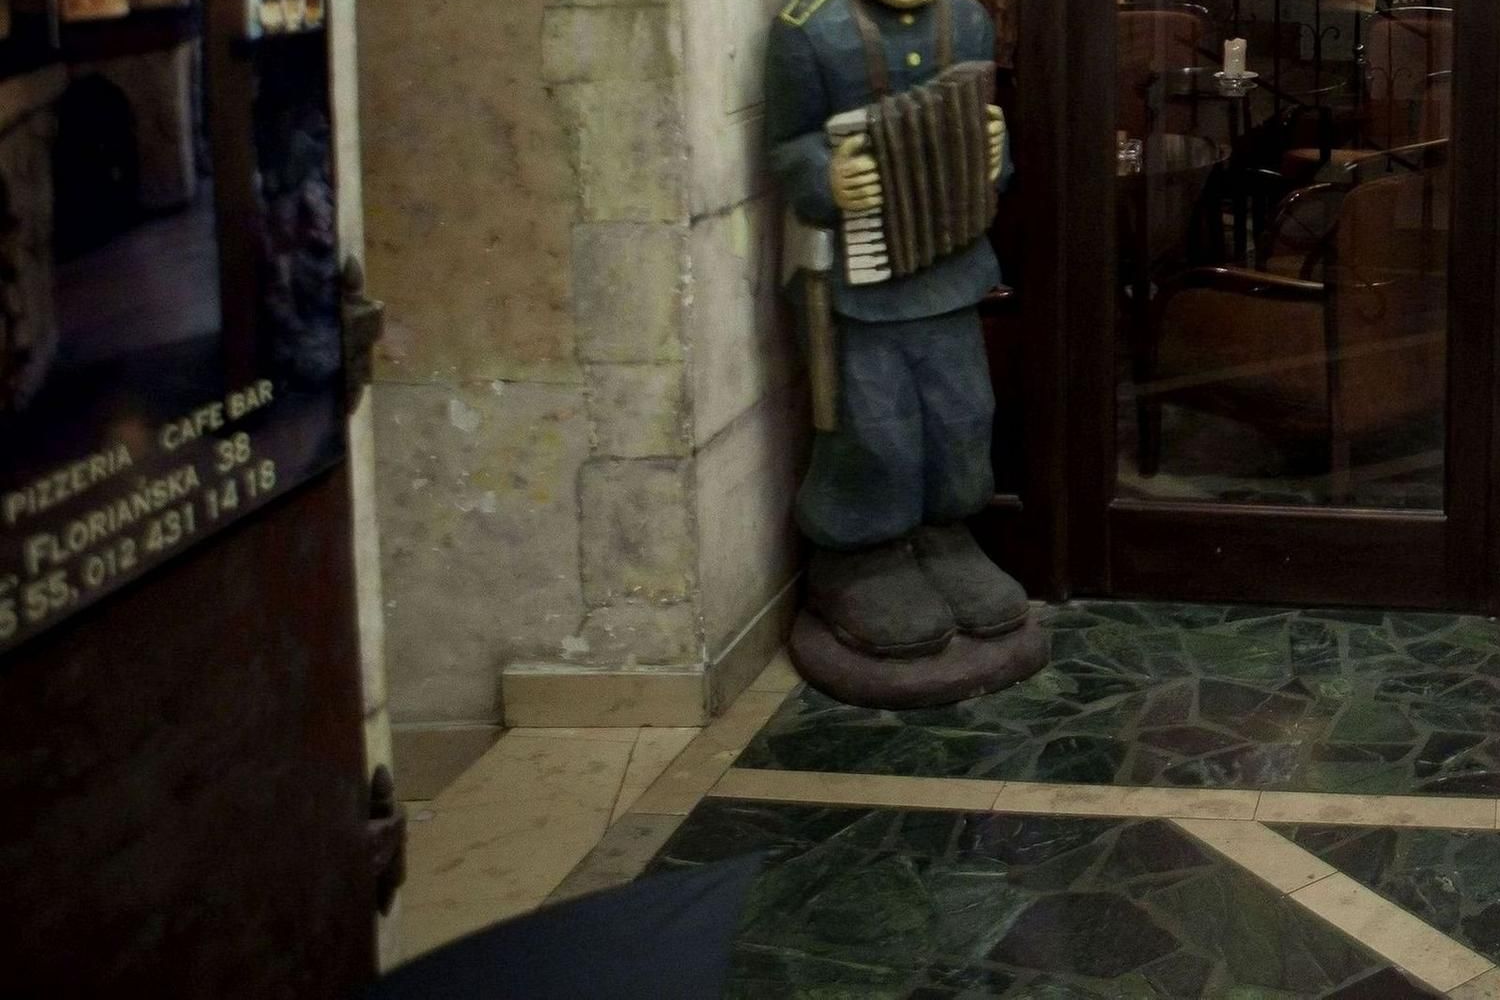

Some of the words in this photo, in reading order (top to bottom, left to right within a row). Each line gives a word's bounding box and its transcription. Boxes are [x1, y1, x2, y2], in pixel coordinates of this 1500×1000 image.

[4, 443, 133, 524] PIZZERIA
[161, 402, 224, 449] CAFE
[225, 379, 274, 420] BAR
[83, 537, 137, 587] 012
[206, 478, 239, 520] 14
